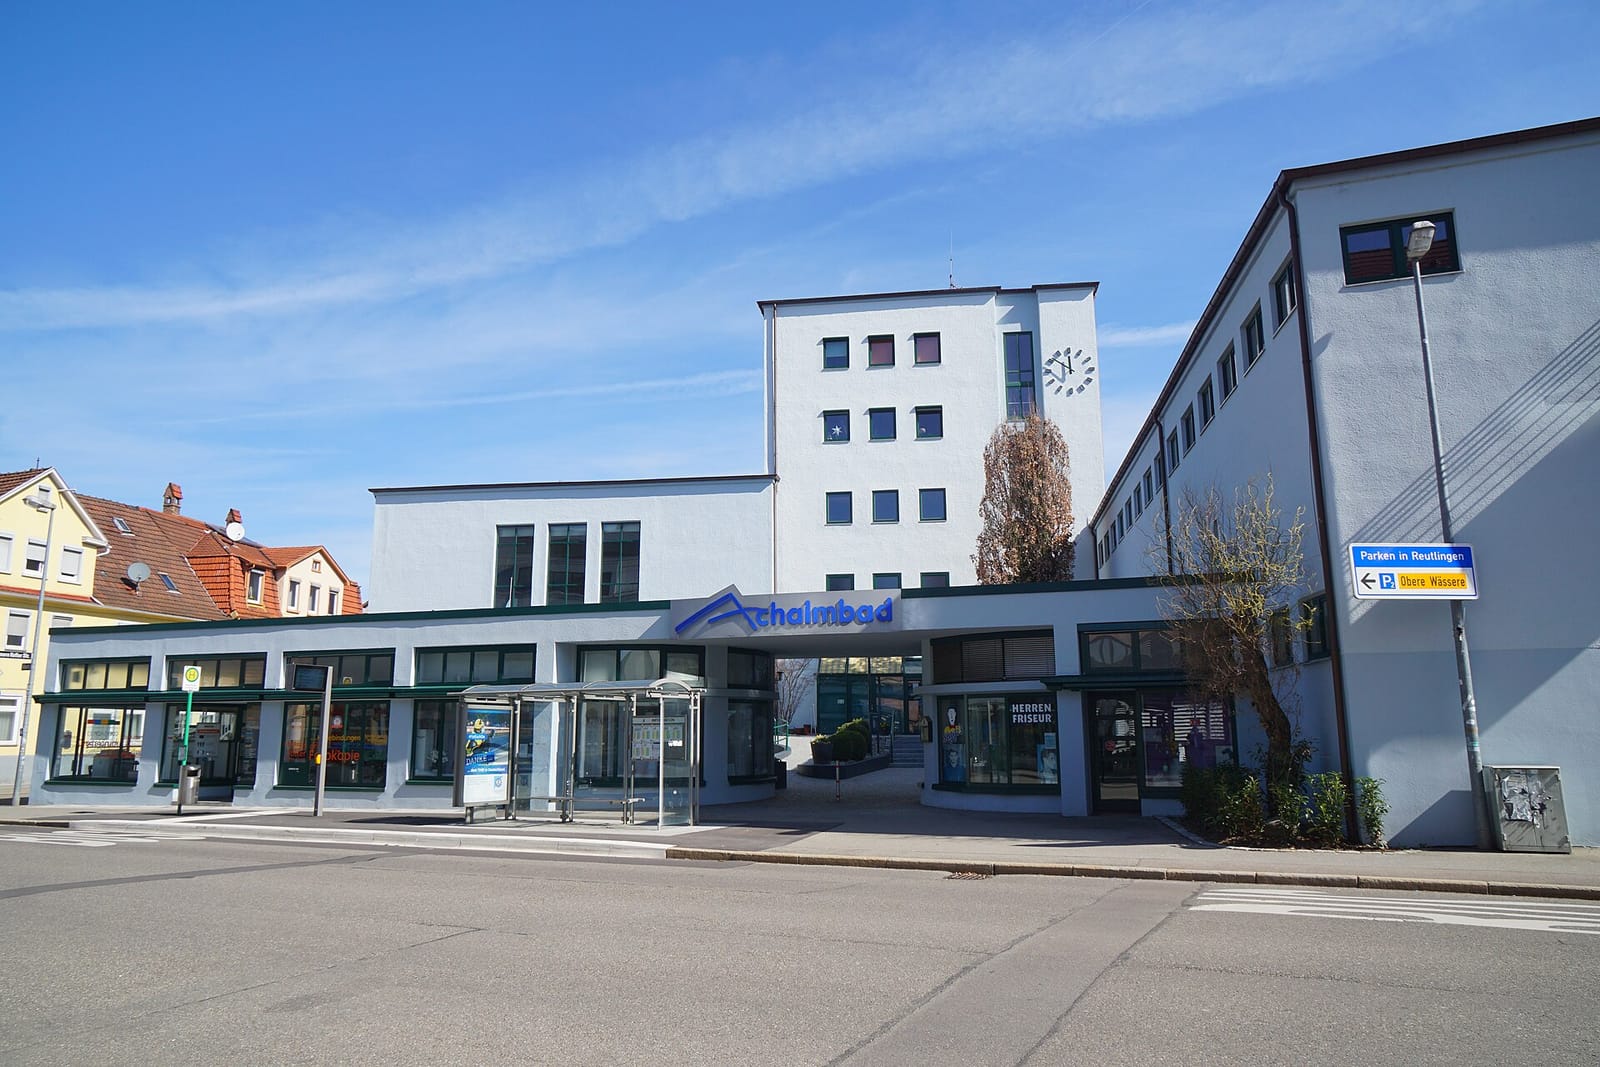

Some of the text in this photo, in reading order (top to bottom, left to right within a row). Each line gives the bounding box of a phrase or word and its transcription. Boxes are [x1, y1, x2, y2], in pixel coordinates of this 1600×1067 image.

[1360, 551, 1464, 562] Parken in Reutlingen
[1401, 576, 1426, 587] Obere
[1430, 576, 1466, 587] Wässere
[675, 592, 893, 634] Achalmbad
[1012, 704, 1052, 712] HERREN
[1012, 714, 1052, 723] FRISEUR
